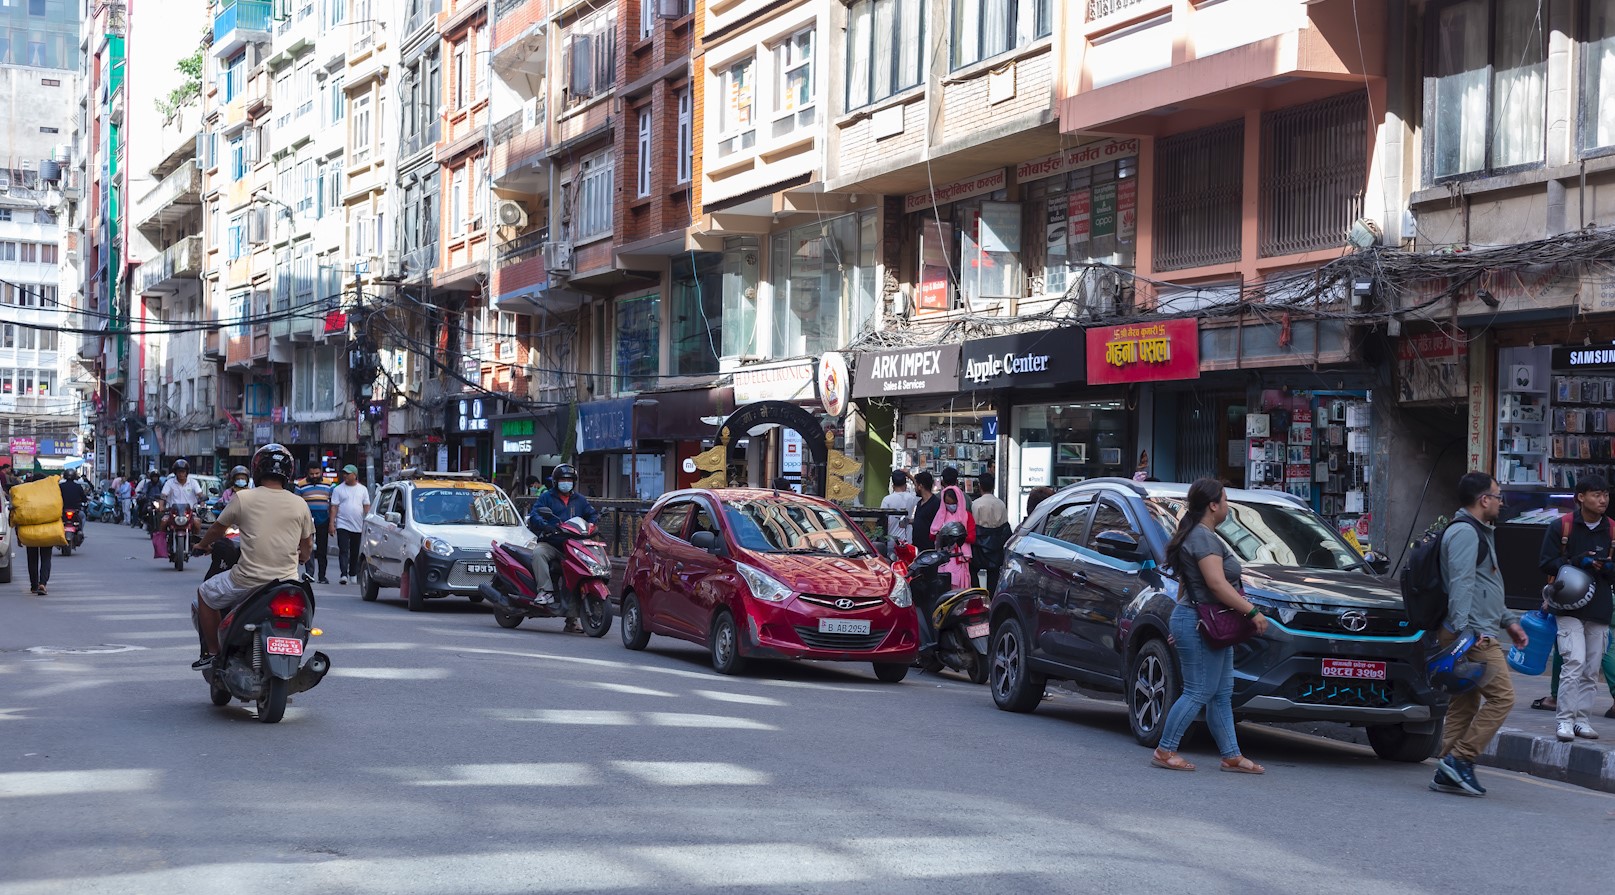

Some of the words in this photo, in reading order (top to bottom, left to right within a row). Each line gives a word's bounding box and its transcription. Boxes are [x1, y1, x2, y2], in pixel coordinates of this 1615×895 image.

[871, 354, 899, 380] ARK
[900, 350, 941, 377] IMPEX
[1105, 340, 1136, 367] गहना
[965, 354, 1003, 383] Apple
[1003, 352, 1050, 374] Center
[883, 381, 898, 392] Sales
[898, 380, 903, 390] &
[903, 379, 926, 390] Services
[828, 623, 834, 632] B
